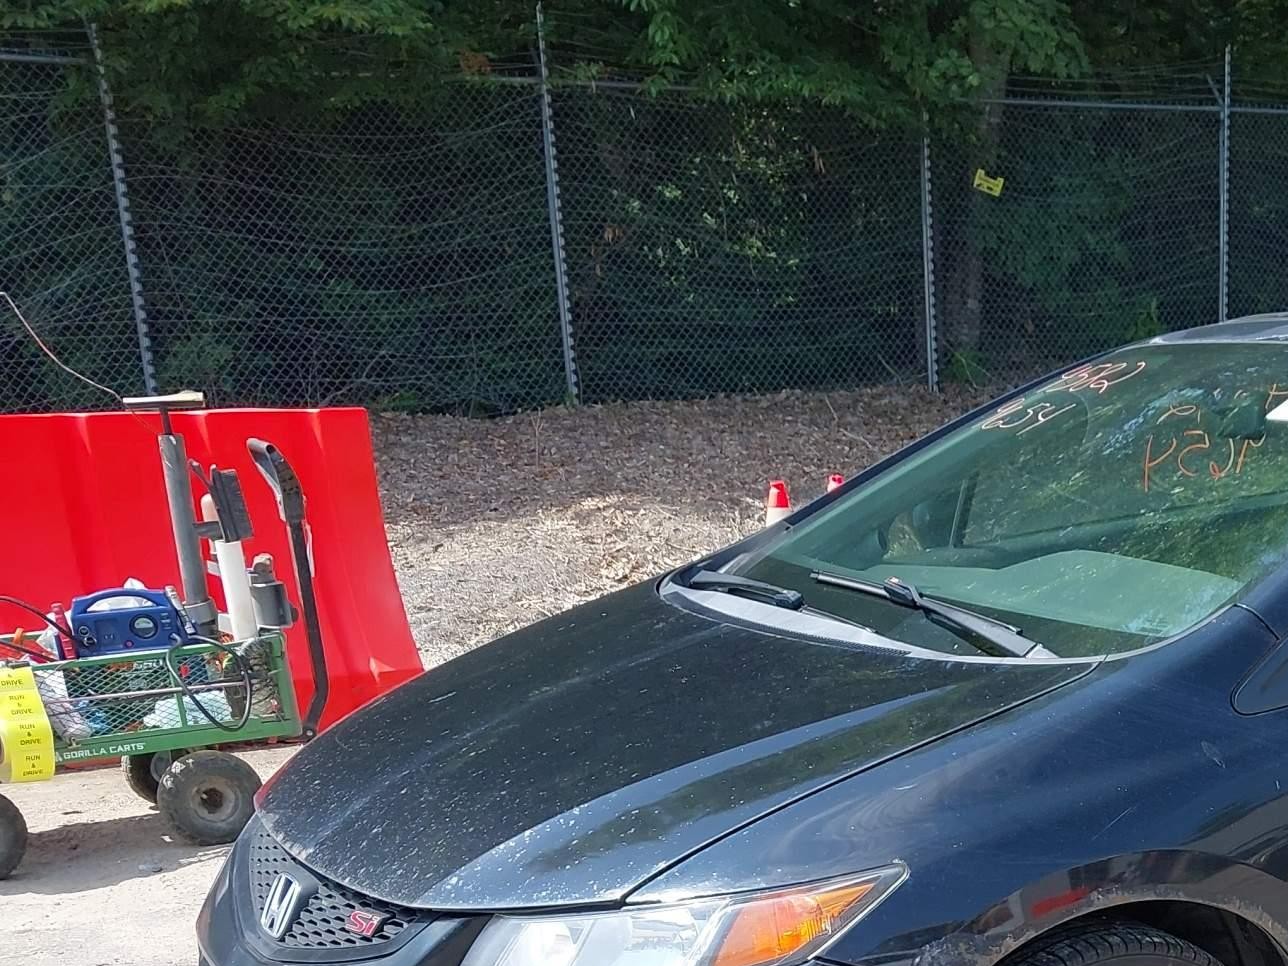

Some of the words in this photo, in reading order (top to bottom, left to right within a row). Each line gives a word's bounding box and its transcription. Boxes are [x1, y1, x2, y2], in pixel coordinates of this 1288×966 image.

[1, 679, 24, 687] DRIVE
[63, 747, 108, 760] GORILLA
[109, 743, 145, 754] CARTS
[343, 909, 381, 937] Si
